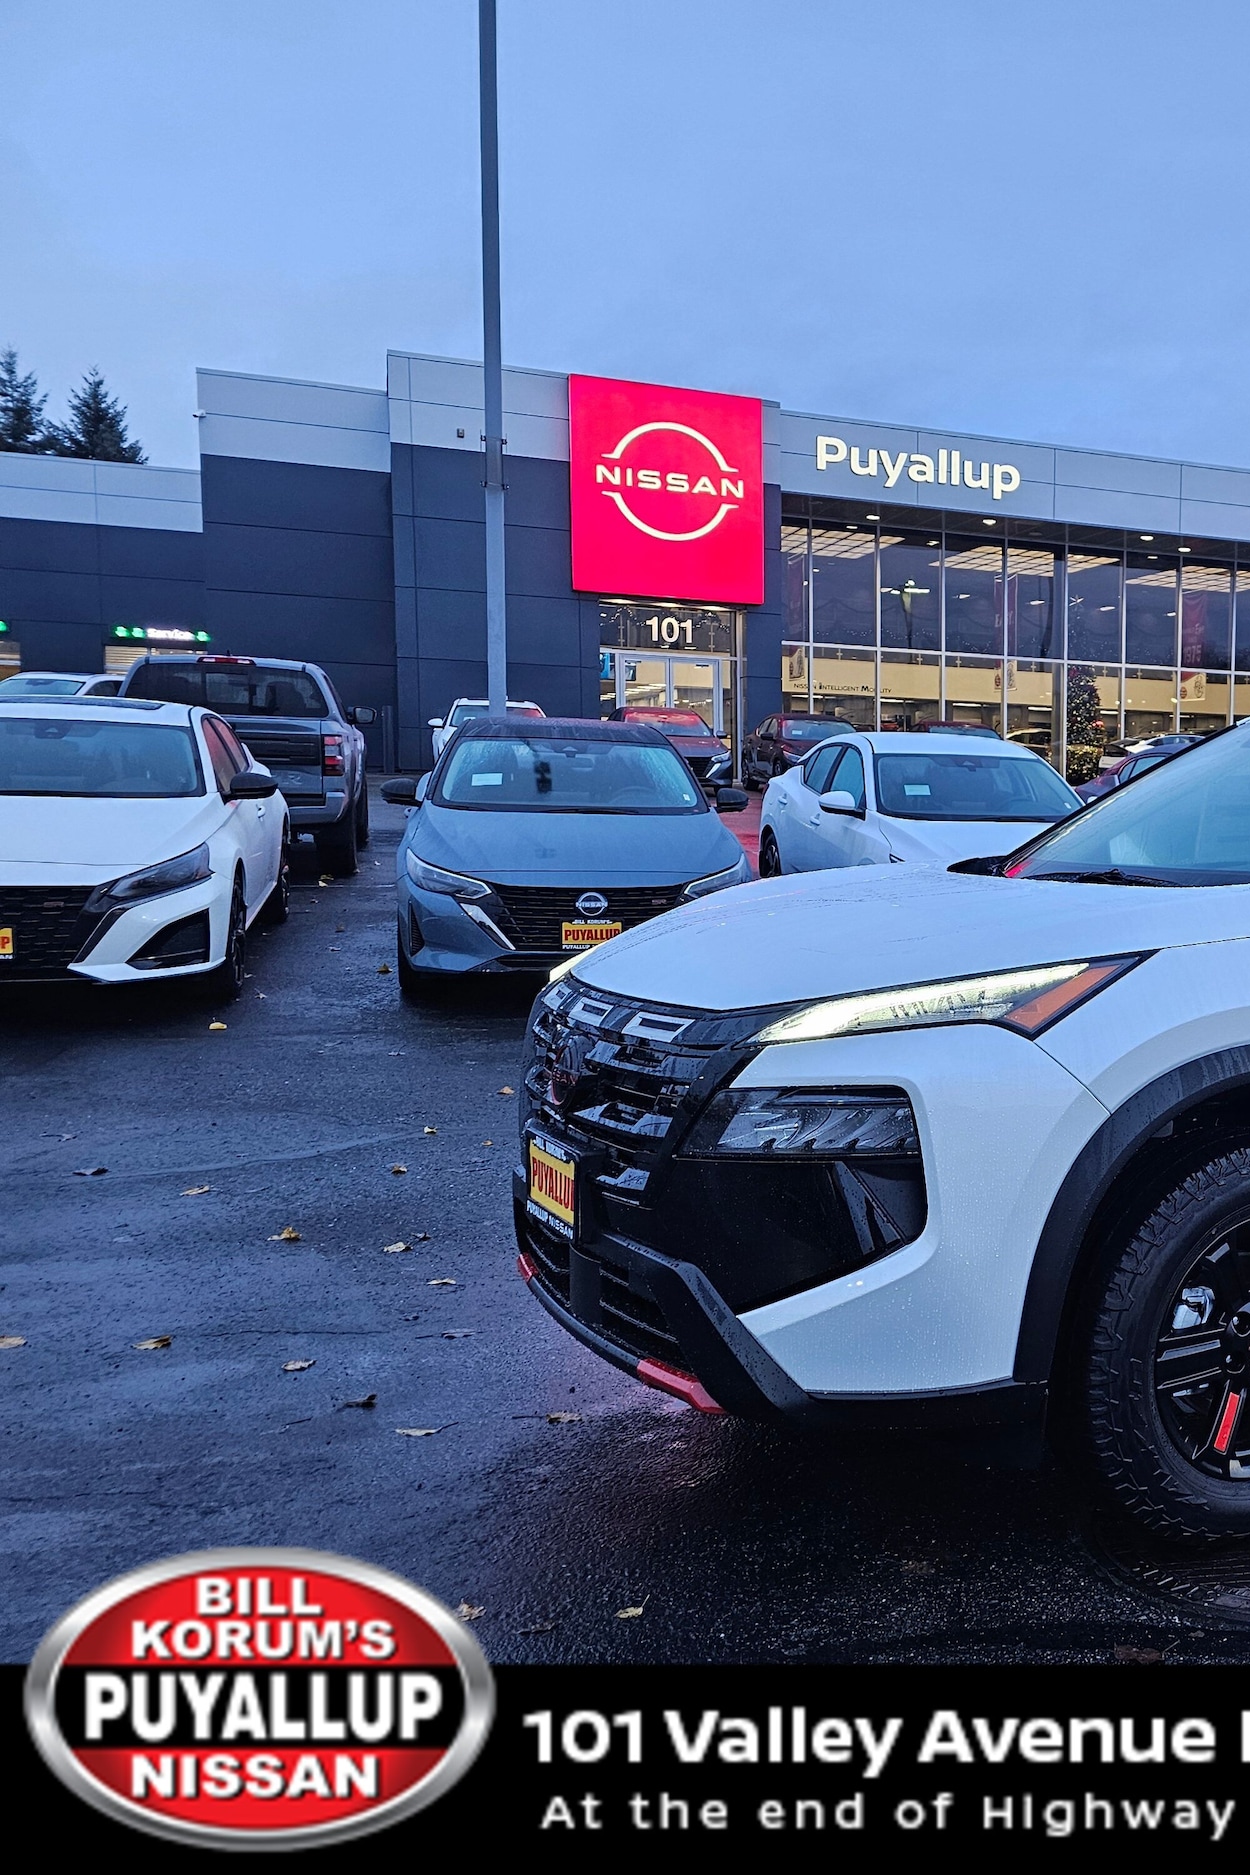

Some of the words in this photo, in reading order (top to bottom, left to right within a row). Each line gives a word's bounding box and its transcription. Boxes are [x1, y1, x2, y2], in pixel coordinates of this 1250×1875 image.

[596, 464, 744, 498] NISSAN
[816, 435, 1021, 500] Puyallup
[646, 615, 693, 643] 101
[548, 1214, 573, 1240] NISSAN
